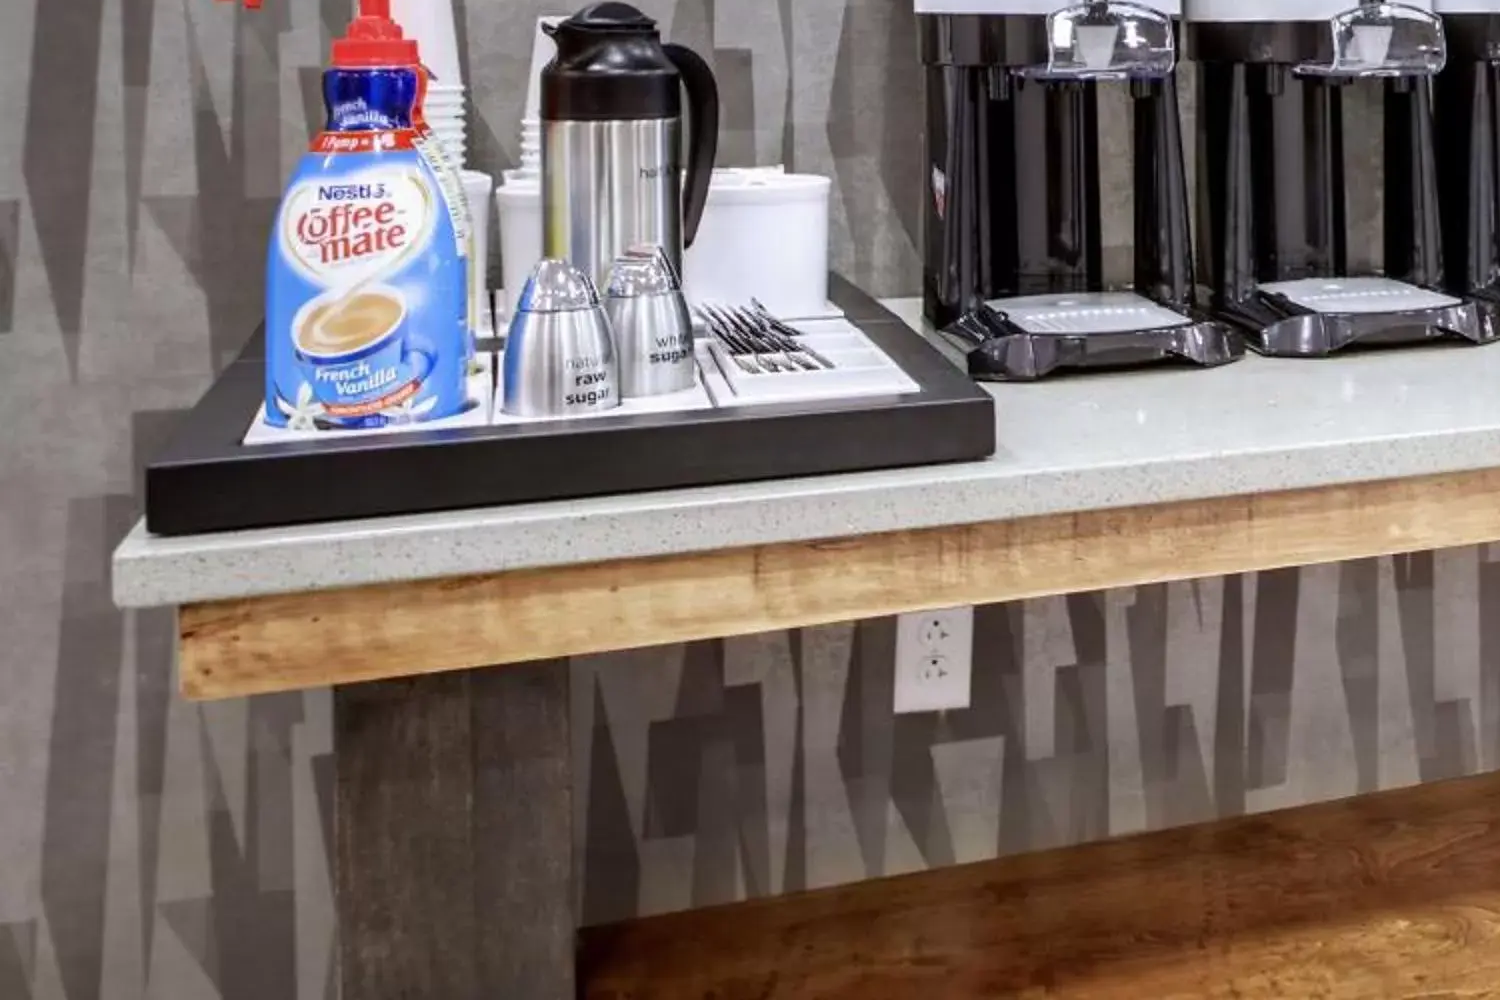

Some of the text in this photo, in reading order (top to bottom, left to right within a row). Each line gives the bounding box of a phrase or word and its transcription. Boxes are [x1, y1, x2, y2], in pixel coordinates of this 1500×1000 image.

[320, 221, 407, 263] mate
[314, 361, 371, 383] French
[335, 366, 398, 396] Vanilla
[575, 371, 607, 387] raw
[565, 387, 610, 406] sugar
